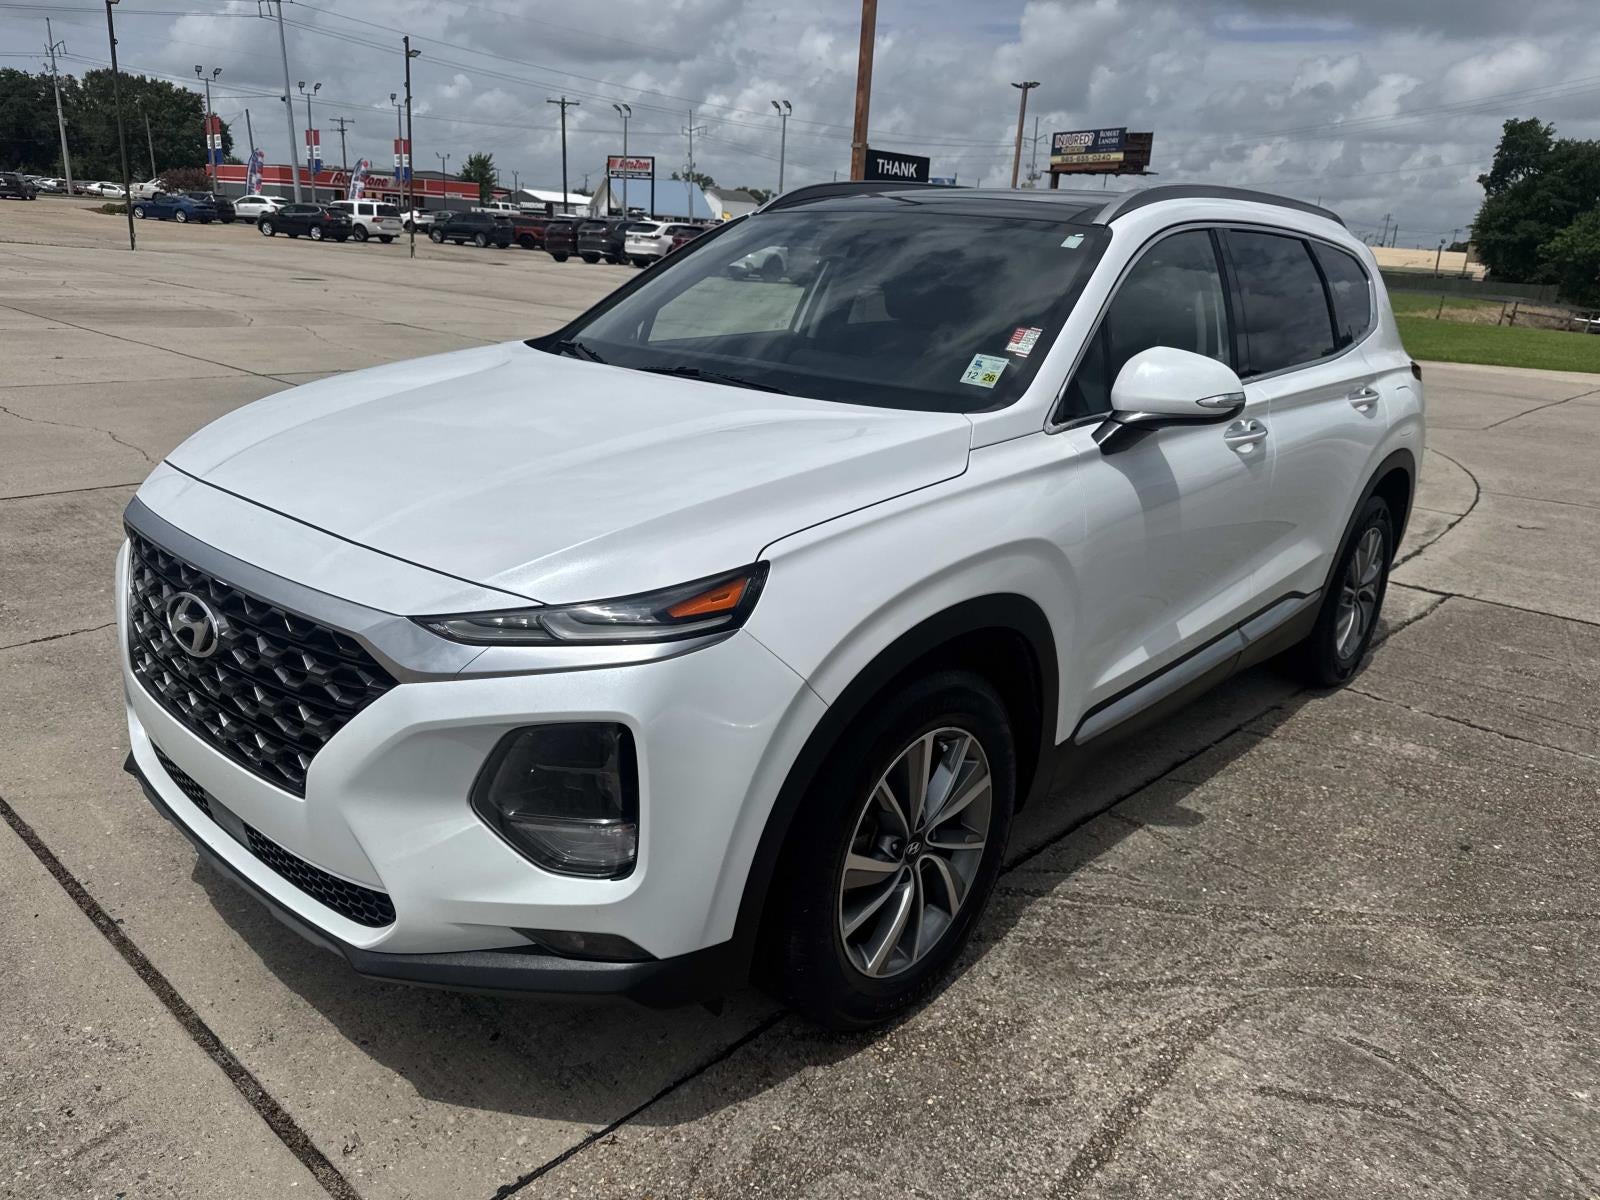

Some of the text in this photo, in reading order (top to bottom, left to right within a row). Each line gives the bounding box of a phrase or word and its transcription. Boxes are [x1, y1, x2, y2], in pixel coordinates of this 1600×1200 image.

[1055, 133, 1095, 148] INJURED?
[877, 158, 917, 178] THANK
[333, 172, 389, 187] AuZone
[967, 371, 978, 379] 12
[983, 373, 996, 382] 26
